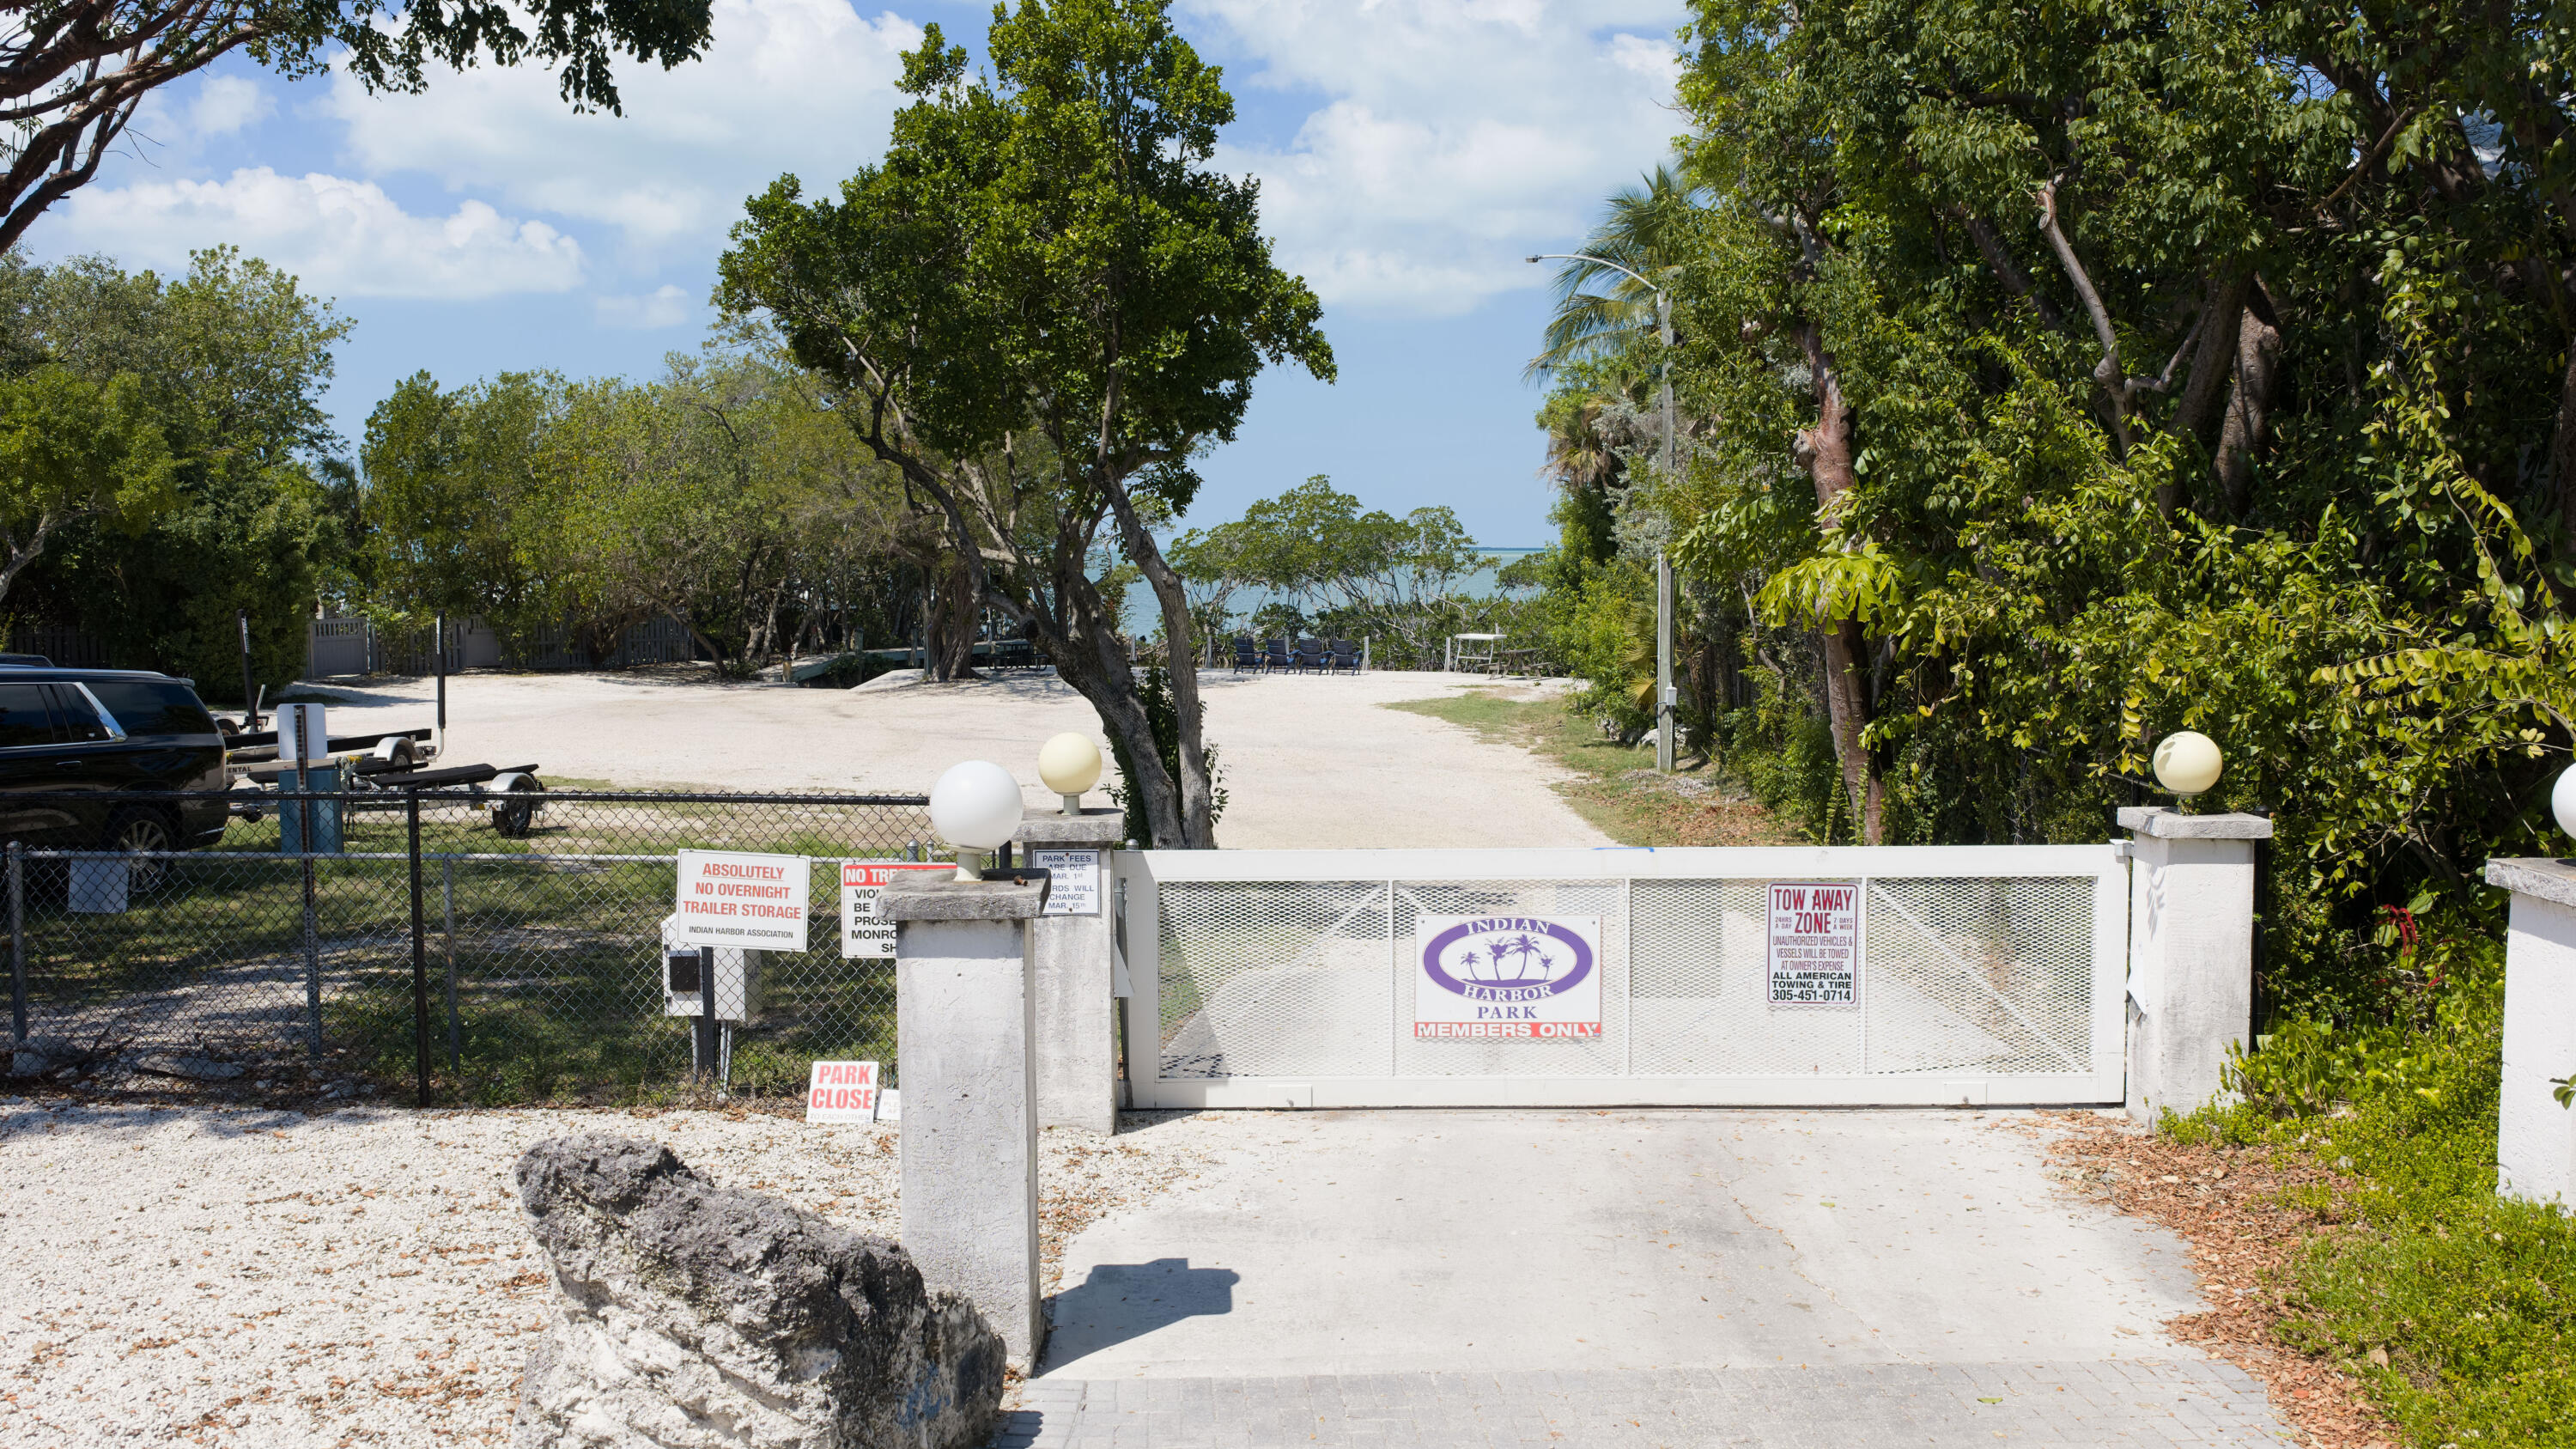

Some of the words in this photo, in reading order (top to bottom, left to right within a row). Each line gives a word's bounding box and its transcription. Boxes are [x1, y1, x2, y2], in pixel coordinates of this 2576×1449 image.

[702, 862, 785, 880] ABSOLUTELY
[845, 868, 866, 883] NO
[869, 868, 898, 883] TRE
[696, 882, 714, 895] NO
[718, 883, 791, 899] OVERNIGHT
[854, 889, 879, 898] VIO
[1774, 889, 1806, 910] TOW
[1812, 890, 1853, 911] AWAY
[683, 900, 737, 916] TRAILER
[742, 904, 801, 919] STORAGE
[854, 904, 871, 912] BE
[1466, 918, 1551, 935] INDIAN
[1795, 912, 1831, 934] ZONE
[747, 929, 793, 938] ASSOCIATION
[1772, 935, 1819, 947] UNAUTHORIZED
[1819, 936, 1846, 947] VEHICLES
[1848, 937, 1853, 947] &
[1777, 948, 1801, 959] VESSELS
[1803, 948, 1818, 959] WILL
[1819, 948, 1826, 959] BE
[1828, 948, 1850, 959] TOWED
[1781, 960, 1788, 971] AT
[1789, 960, 1817, 971] OWNER'S
[1819, 961, 1844, 971] EXPENSE
[1828, 981, 1851, 989] TIRE
[1463, 984, 1554, 1002] HARBOR
[1772, 989, 1851, 1002] 305-451-0714
[1477, 1006, 1538, 1019] PARK
[1417, 1023, 1532, 1038] MEMBERS
[1539, 1023, 1599, 1038] ONLY
[817, 1065, 872, 1084] PARK
[811, 1088, 872, 1110] CLOSE
